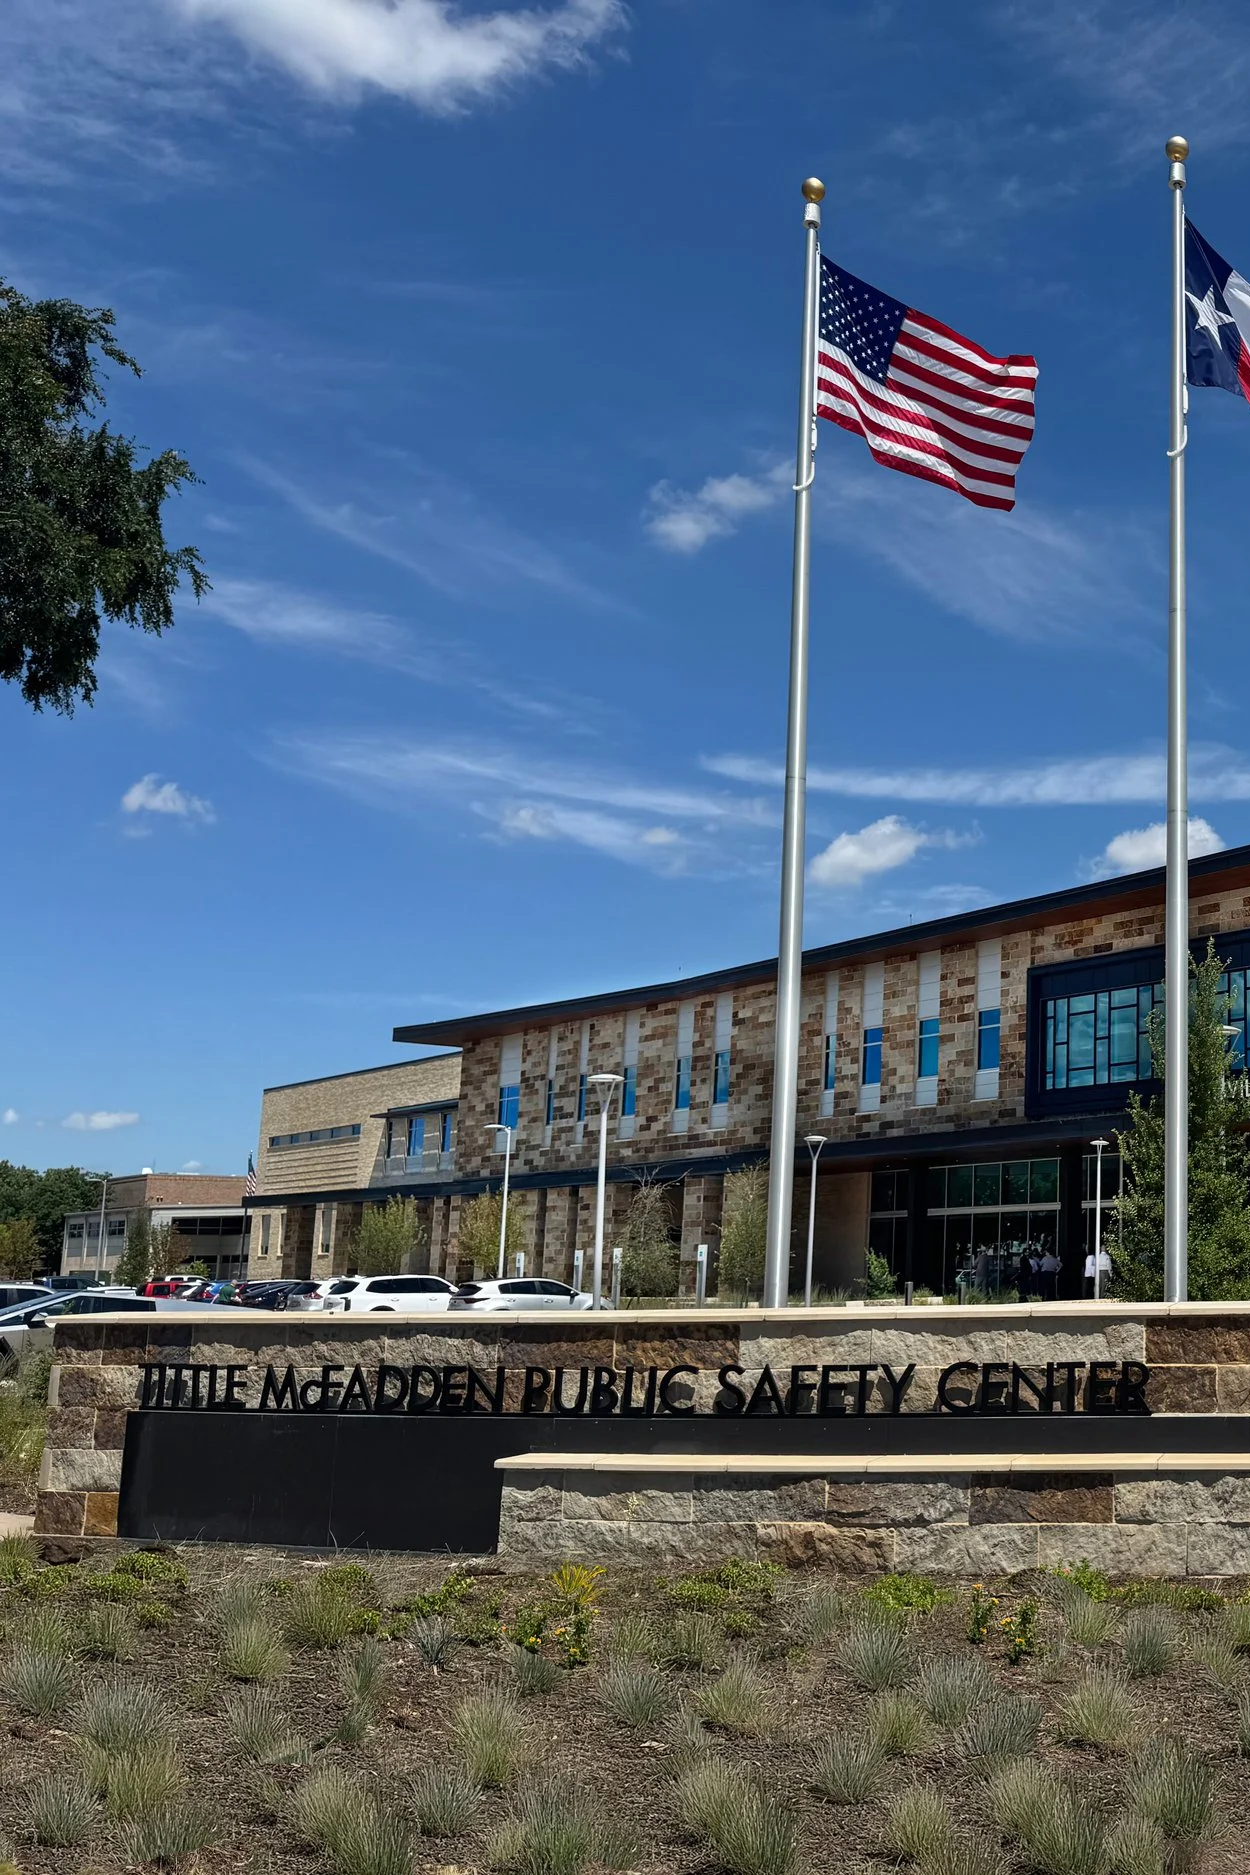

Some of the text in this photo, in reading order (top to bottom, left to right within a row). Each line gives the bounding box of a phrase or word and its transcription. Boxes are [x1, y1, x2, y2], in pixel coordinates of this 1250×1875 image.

[138, 1361, 1152, 1414] TITTLE McFADDEN PUBLIC SAFETY CENTER
